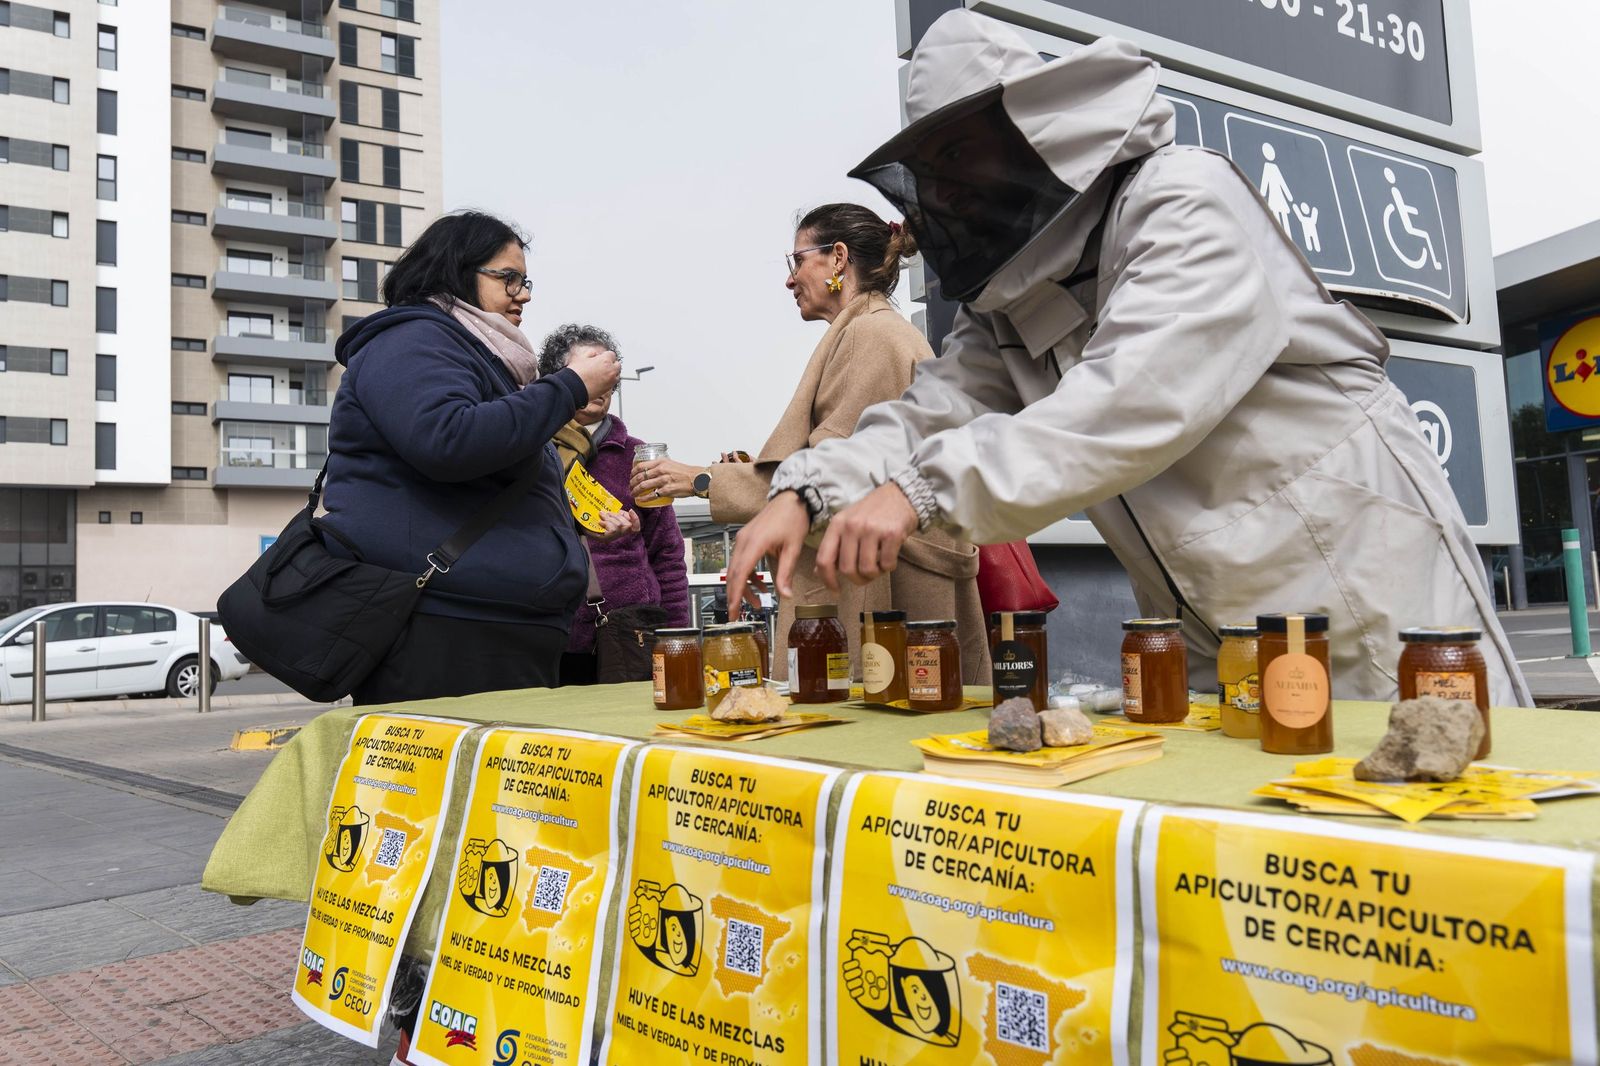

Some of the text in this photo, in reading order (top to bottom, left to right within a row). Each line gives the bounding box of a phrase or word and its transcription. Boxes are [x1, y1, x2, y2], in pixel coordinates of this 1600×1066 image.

[1336, 0, 1425, 62] 21:30
[355, 737, 444, 761] APICULTOR/APICULTORA
[385, 725, 425, 740] BUSCA TU
[366, 754, 417, 774] DE CERCANÍA:
[520, 742, 571, 761] BUSCA TU
[486, 756, 603, 788] APICULTOR/APICULTORA
[503, 777, 570, 802] DE CERCANÍA:
[691, 768, 756, 793] BUSCA TU
[648, 783, 804, 828] APICULTOR/APICULTORA
[925, 799, 1022, 832] BUSCA TU
[675, 811, 762, 844] DE CERCANÍA:
[662, 840, 771, 876] www.coag.org/apicultura
[861, 815, 1096, 877] APICULTOR/APICULTORA
[905, 849, 1035, 893] DE CERCANÍA:
[1264, 853, 1411, 896] BUSCA TU
[328, 892, 337, 905] DE
[337, 895, 351, 911] LAS
[352, 900, 394, 924] MEZCLAS
[887, 883, 1055, 932] www.coag.org/apicultura
[1175, 873, 1536, 954] APICULTOR/APICULTORA
[321, 912, 338, 929] VERDAD
[339, 920, 344, 930] Y
[344, 922, 352, 933] DE
[352, 925, 394, 948] PROXIMIDAD
[1245, 916, 1445, 973] DE CERCANÍA:
[303, 948, 325, 973] COAG
[450, 931, 572, 980] HUYE DE LAS MEZCLAS
[440, 953, 580, 1008] MIEL DE VERDAD Y DE PROXIMIDAD
[1221, 956, 1478, 1022] www.coag.org/apicultura
[344, 993, 372, 1015] CECU
[430, 1001, 477, 1035] COAG
[628, 987, 785, 1054] HUYE DE LAS MEZCLAS
[524, 1042, 568, 1059] CONSUMIDORES
[616, 1012, 636, 1032] MIEL
[638, 1020, 649, 1037] DE
[651, 1026, 689, 1053] VERDAD
[693, 1044, 702, 1056] Y
[703, 1047, 717, 1063] DE
